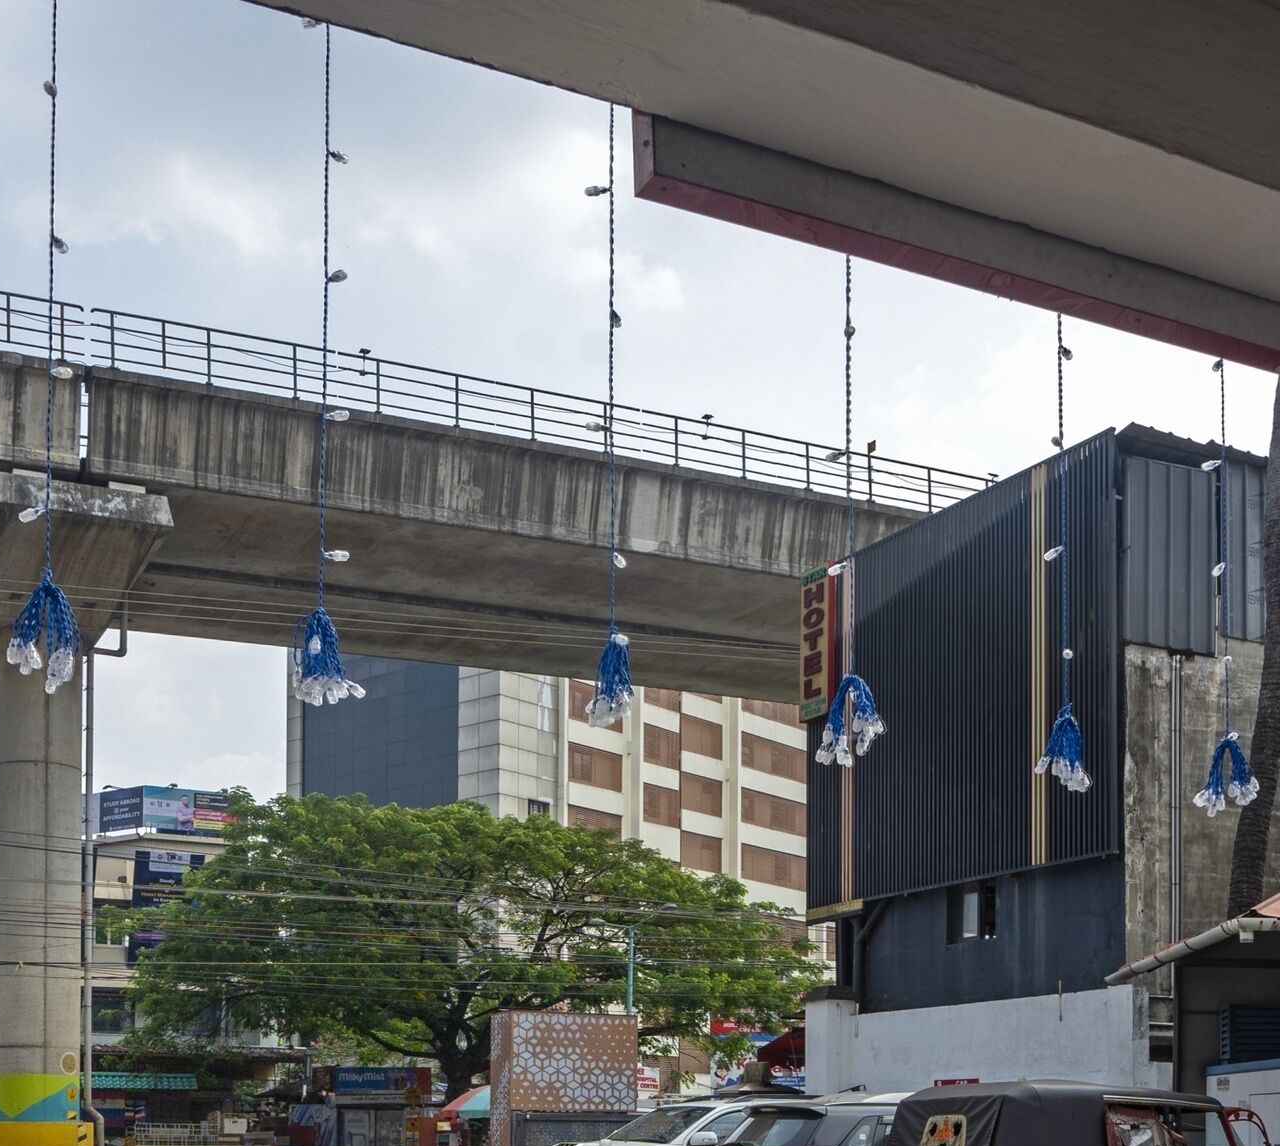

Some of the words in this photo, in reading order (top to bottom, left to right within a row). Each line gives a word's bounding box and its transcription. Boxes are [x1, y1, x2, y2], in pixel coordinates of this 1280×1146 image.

[803, 582, 825, 699] HOTEL
[119, 797, 141, 805] ABROAD
[102, 811, 140, 822] AFFORDABILITY
